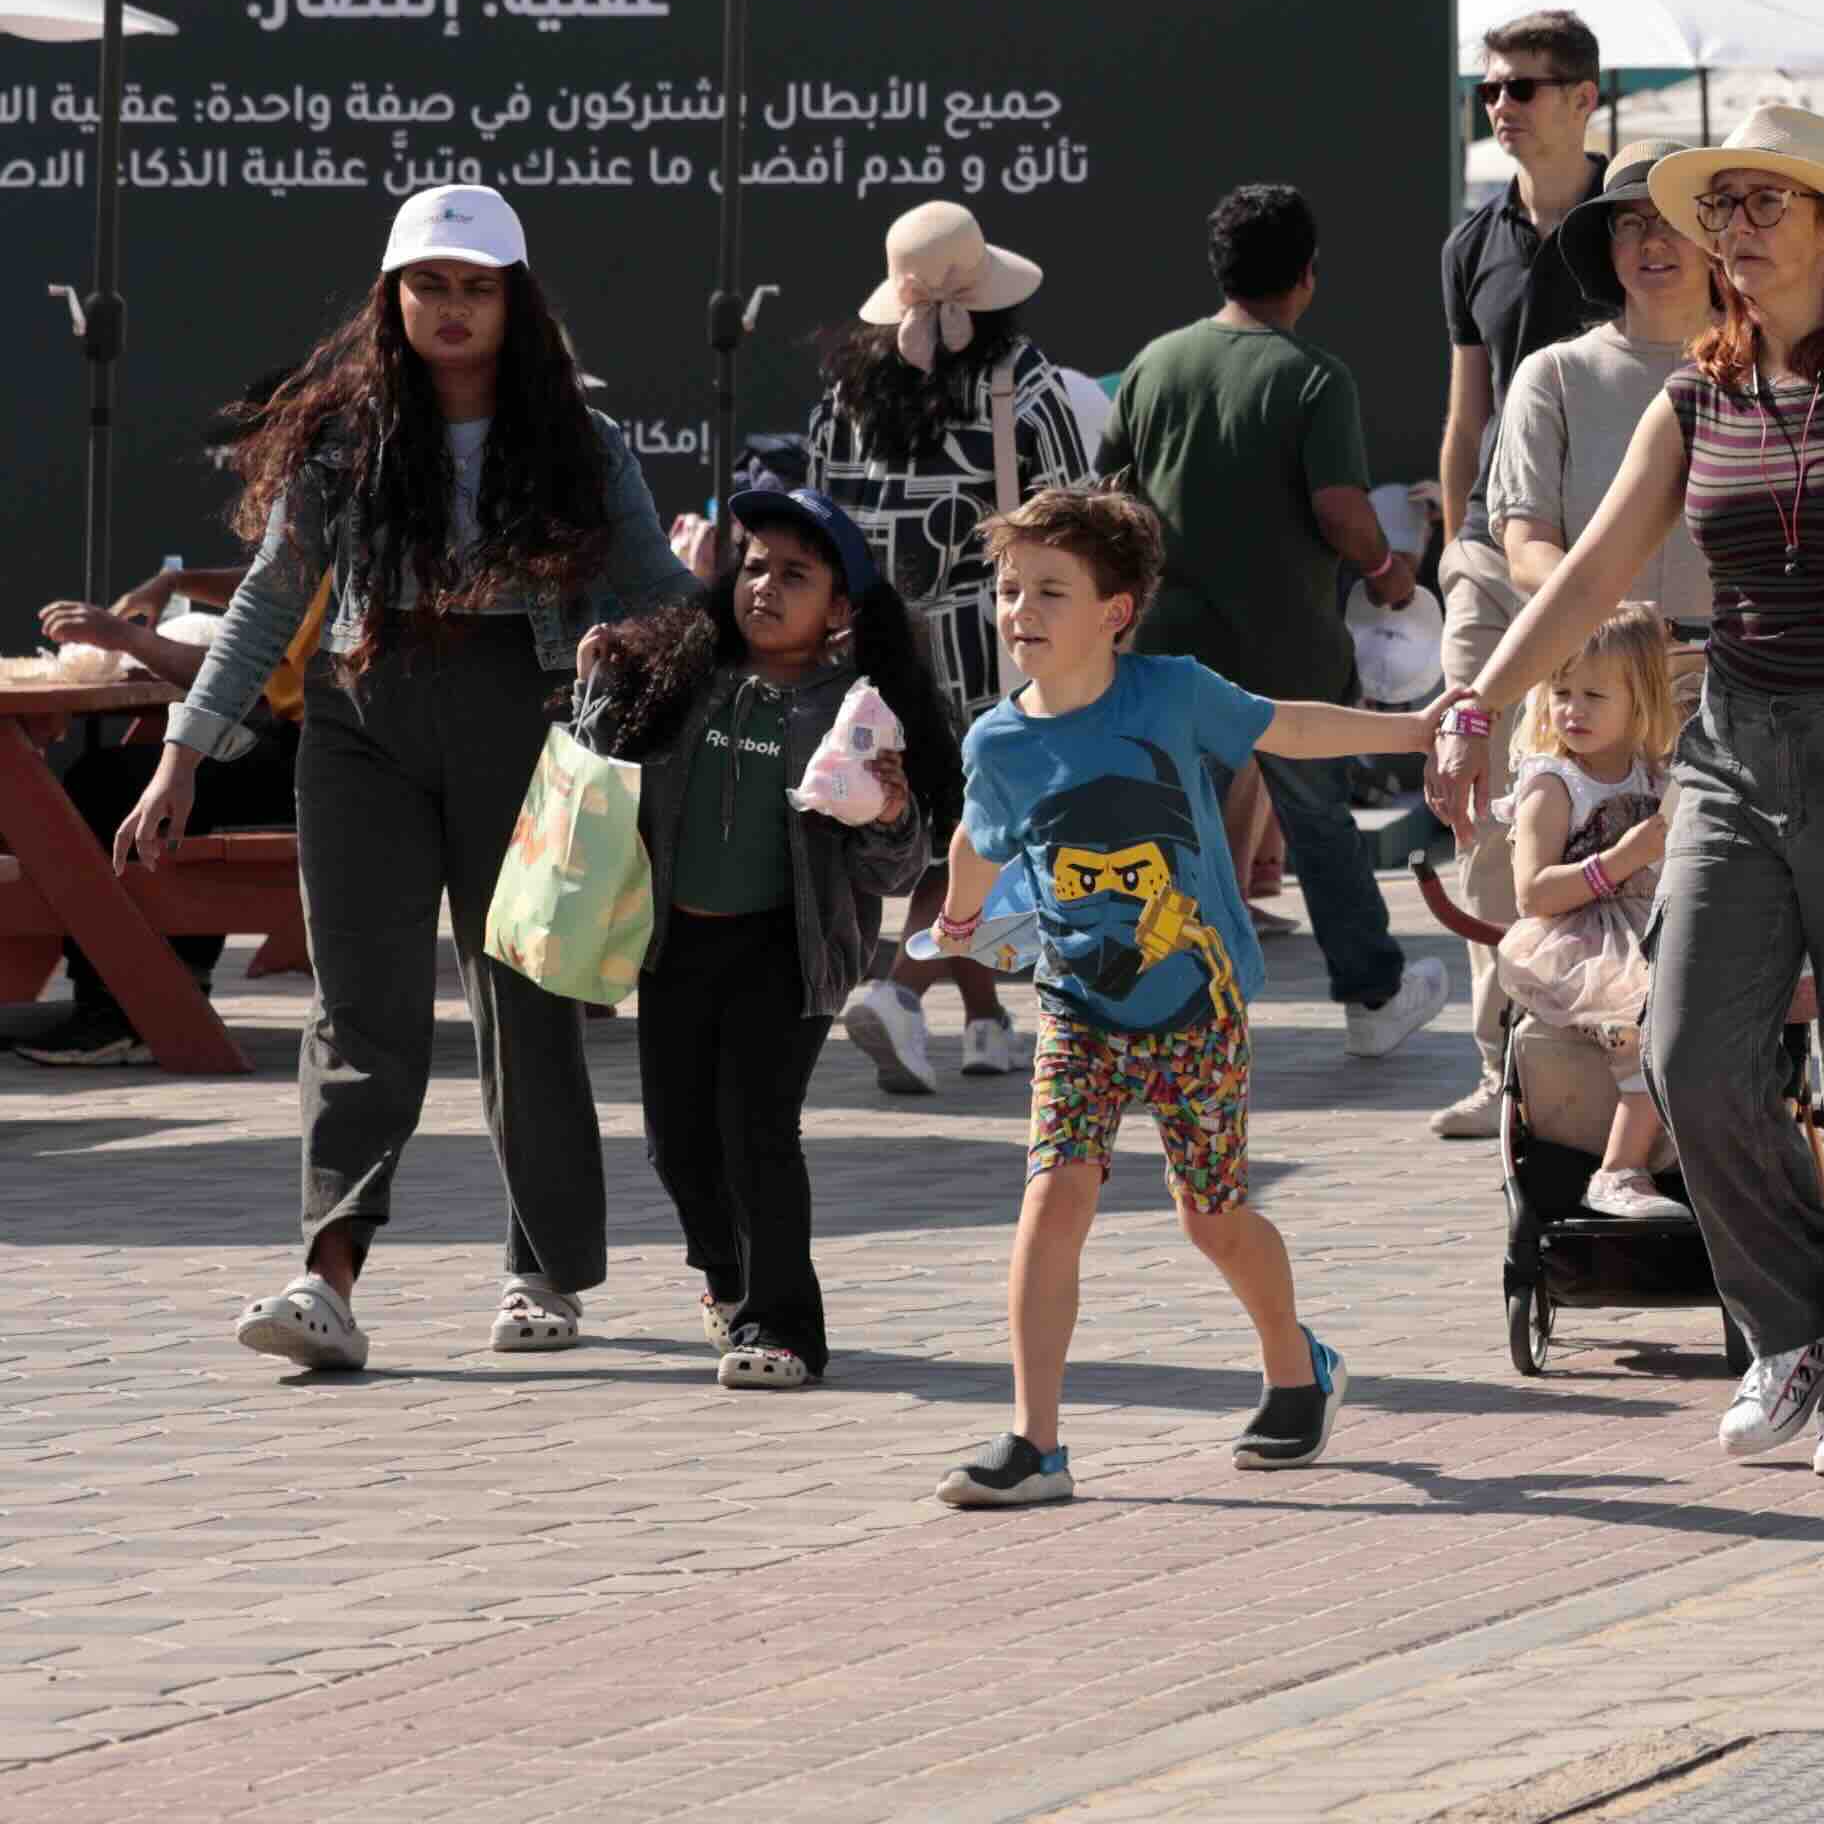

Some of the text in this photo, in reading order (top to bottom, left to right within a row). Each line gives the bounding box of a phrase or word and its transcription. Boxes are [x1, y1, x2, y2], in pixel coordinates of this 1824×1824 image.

[346, 82, 455, 123] صفة
[470, 82, 532, 139] في
[765, 77, 926, 129] الأبطال
[944, 88, 1062, 138] جميع
[242, 146, 368, 197] عقلية
[650, 146, 693, 185] ما
[708, 135, 845, 194] أفض
[858, 146, 946, 201] قدم
[961, 157, 985, 192] و
[1002, 137, 1087, 193] تألق
